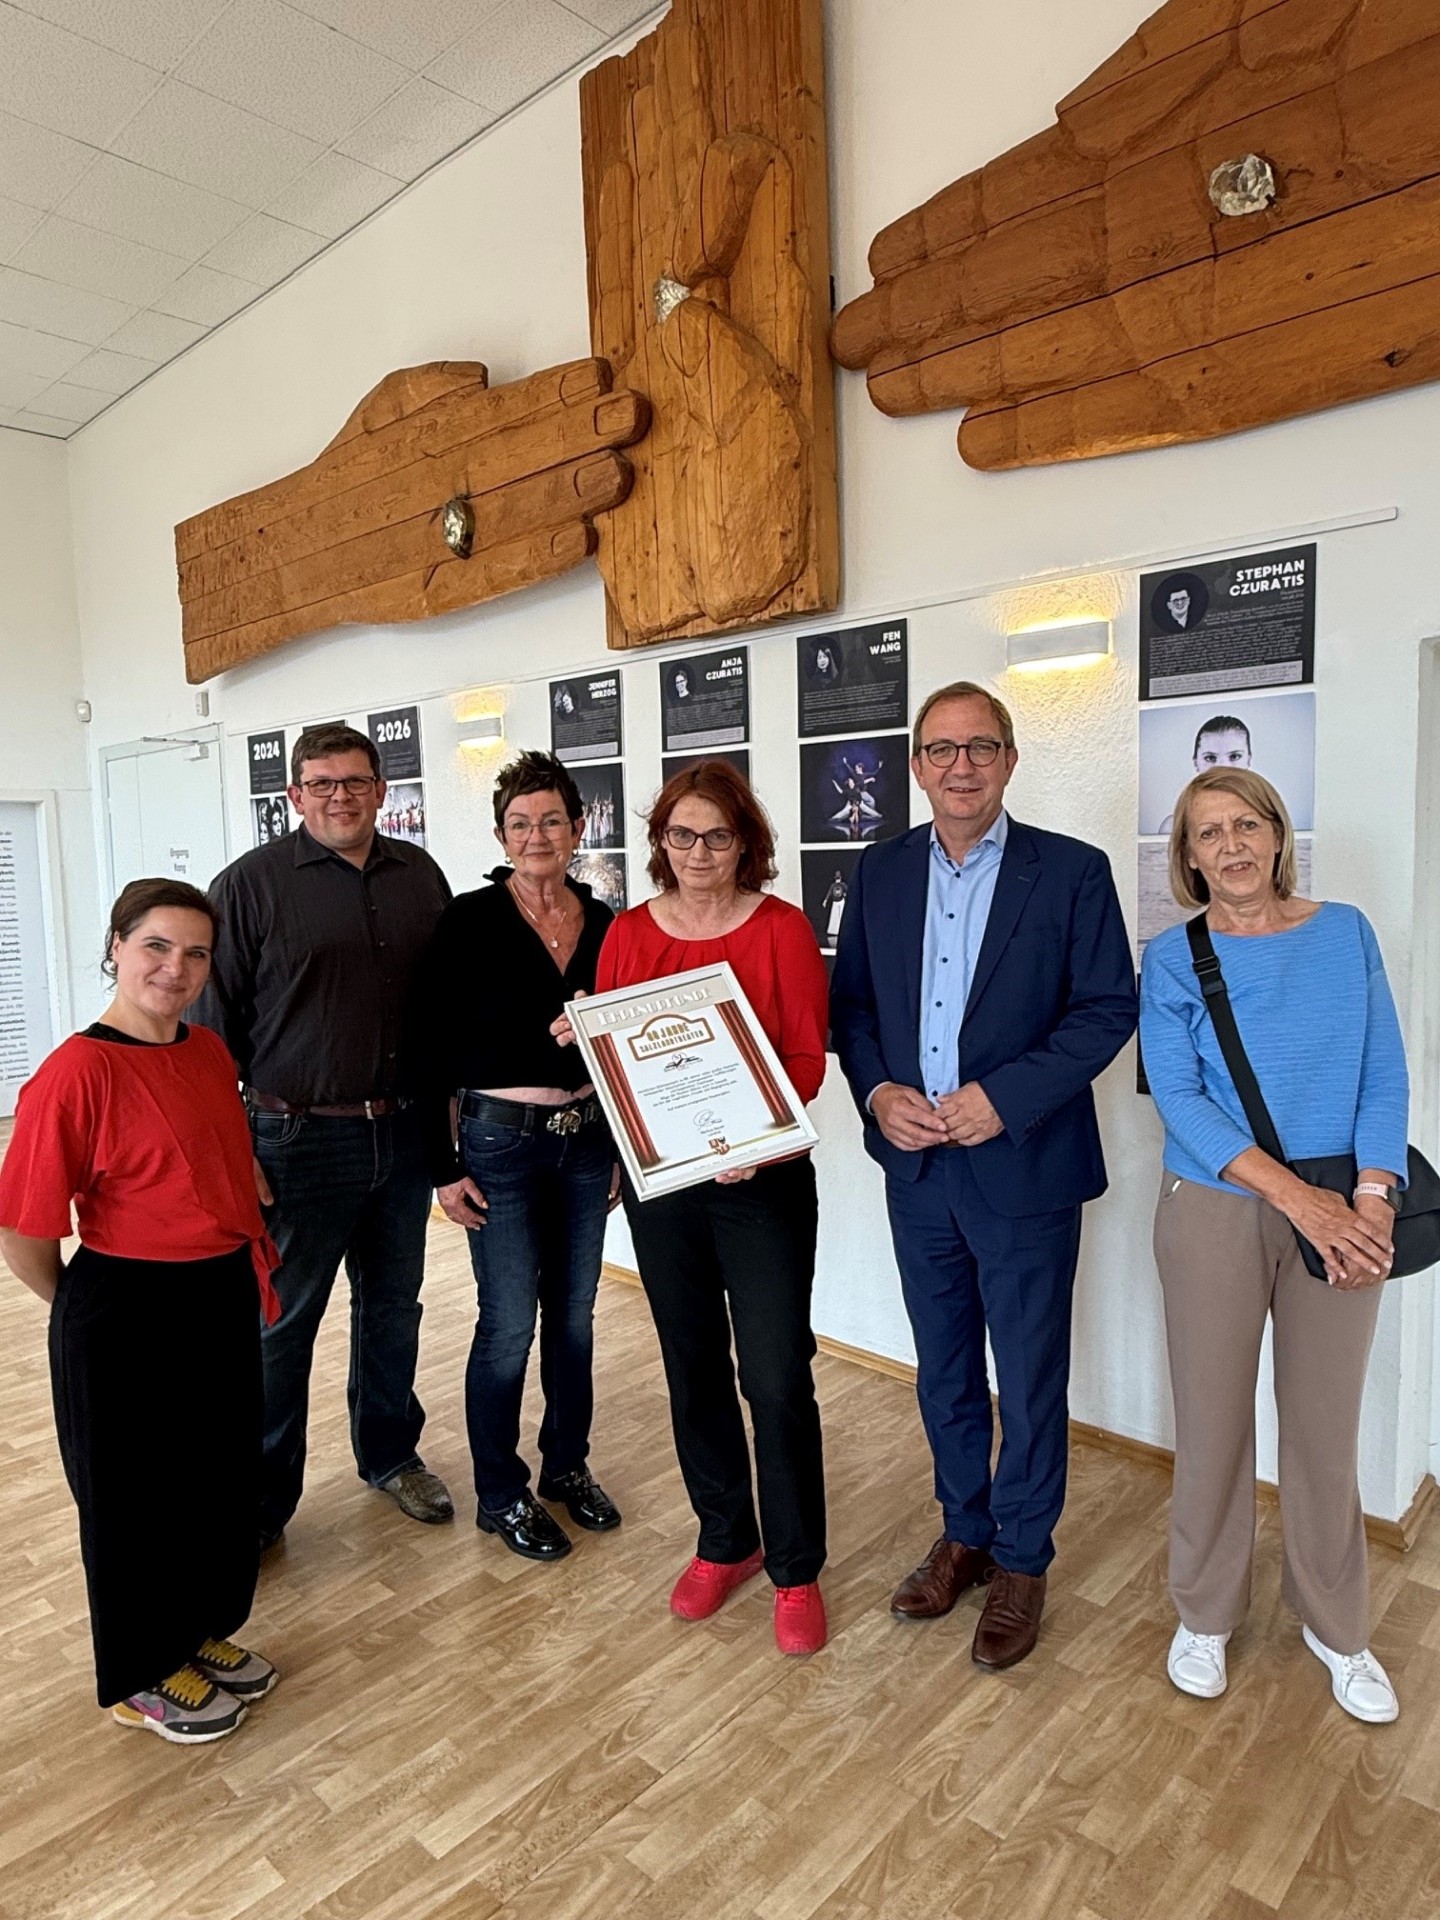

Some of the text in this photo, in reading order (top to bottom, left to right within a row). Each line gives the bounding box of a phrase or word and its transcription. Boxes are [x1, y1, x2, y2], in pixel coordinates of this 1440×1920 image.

[1236, 559, 1305, 582] STEPHAN
[1229, 573, 1305, 596] CZURATIS
[882, 630, 901, 642] FEN
[869, 642, 901, 655] WANG
[721, 656, 743, 668] ANJA
[705, 666, 743, 681] CZURATIS
[591, 687, 617, 699] HERZOG
[376, 718, 412, 743] 2026
[253, 740, 280, 761] 2024
